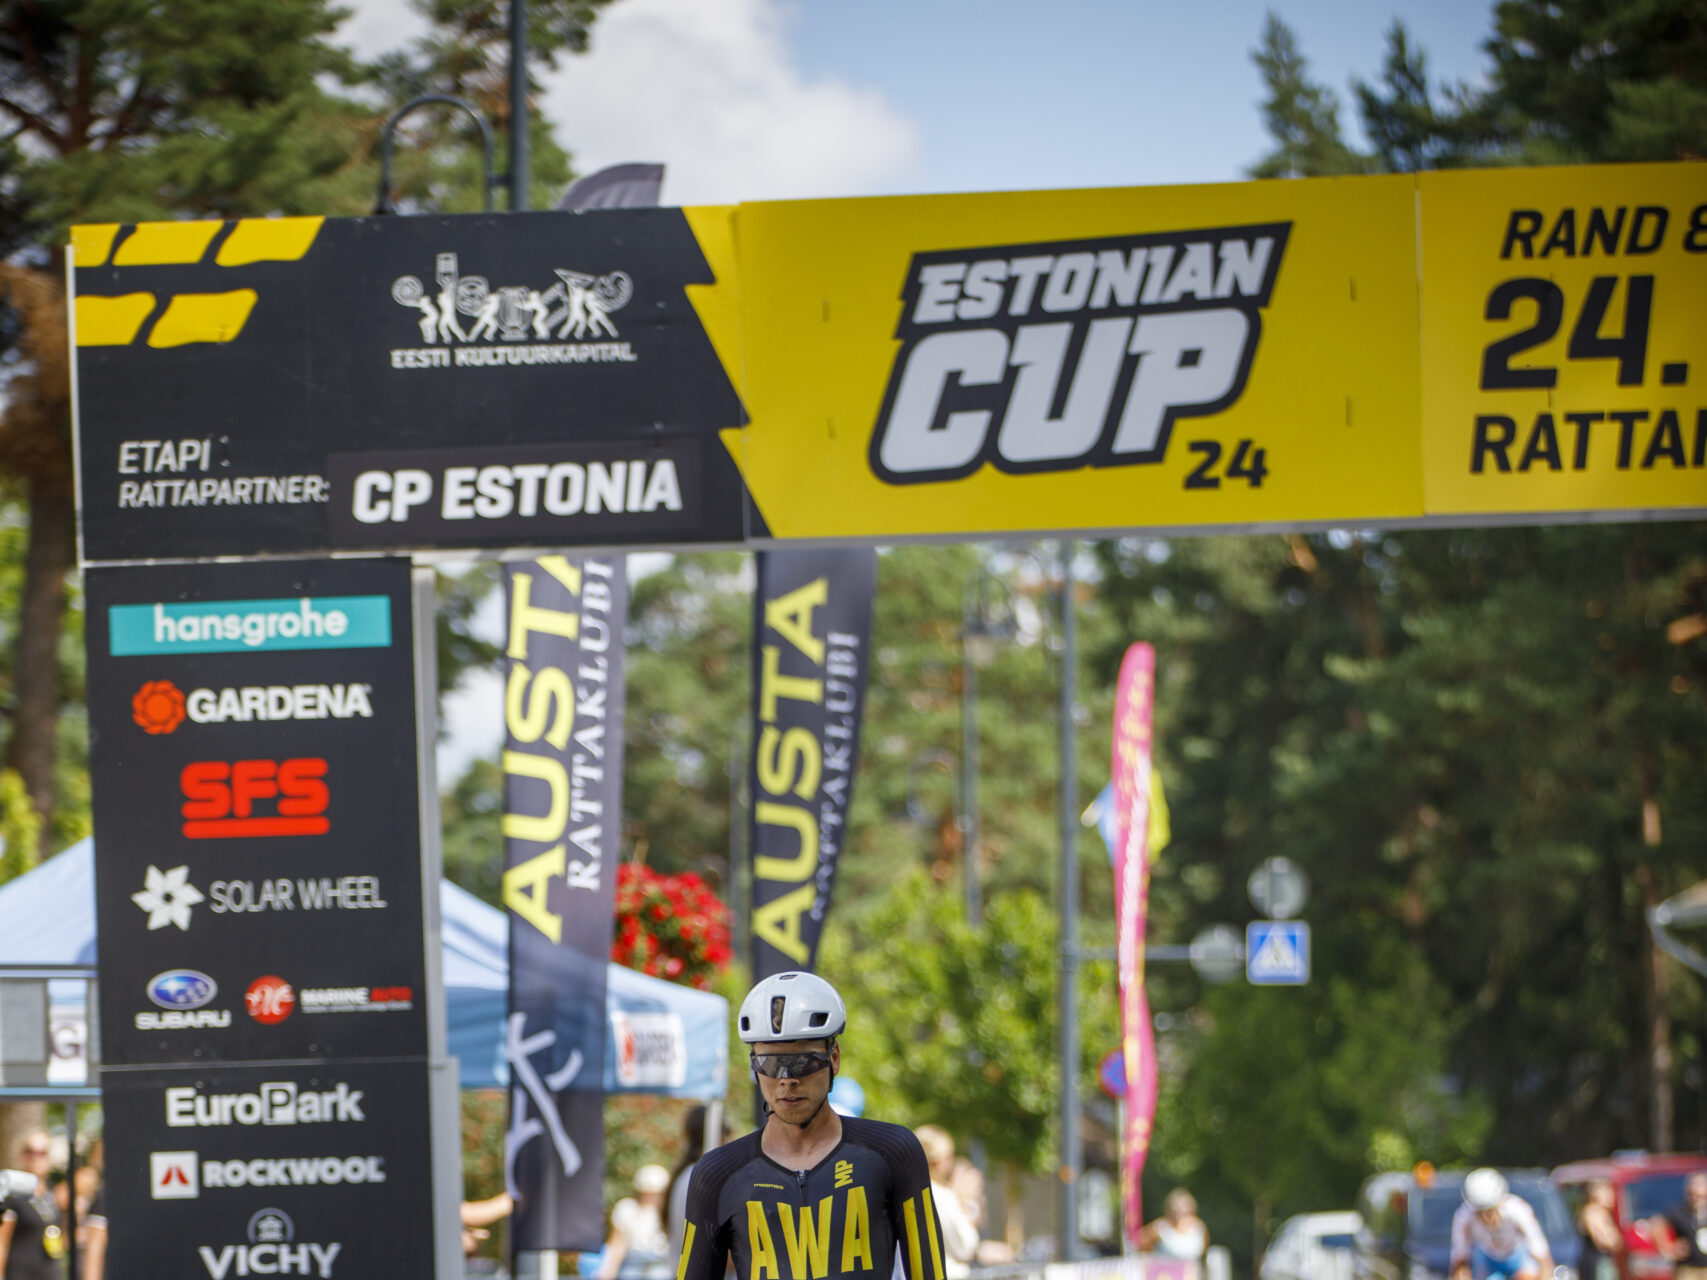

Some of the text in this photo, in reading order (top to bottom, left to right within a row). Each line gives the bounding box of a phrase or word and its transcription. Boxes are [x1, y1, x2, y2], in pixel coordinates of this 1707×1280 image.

[1499, 205, 1669, 260] RAND
[911, 236, 1276, 325] ESTONIAN
[391, 342, 637, 368] EESTI KULTUURKAPITAL
[1480, 273, 1689, 391] 24.
[879, 306, 1251, 474] CUP
[118, 439, 210, 475] ETAPI
[1183, 438, 1269, 491] 24
[118, 474, 330, 509] RATTAPARTNER:
[352, 459, 684, 524] CP ESTONIA
[153, 597, 350, 647] hansgrohe
[186, 682, 374, 722] GARDENA
[180, 757, 331, 820] SFS
[753, 575, 829, 966] AUSTA
[208, 875, 388, 914] SOLAR WHEEL
[165, 1081, 365, 1127] EuroPark
[203, 1156, 386, 1188] ROCKWOOL
